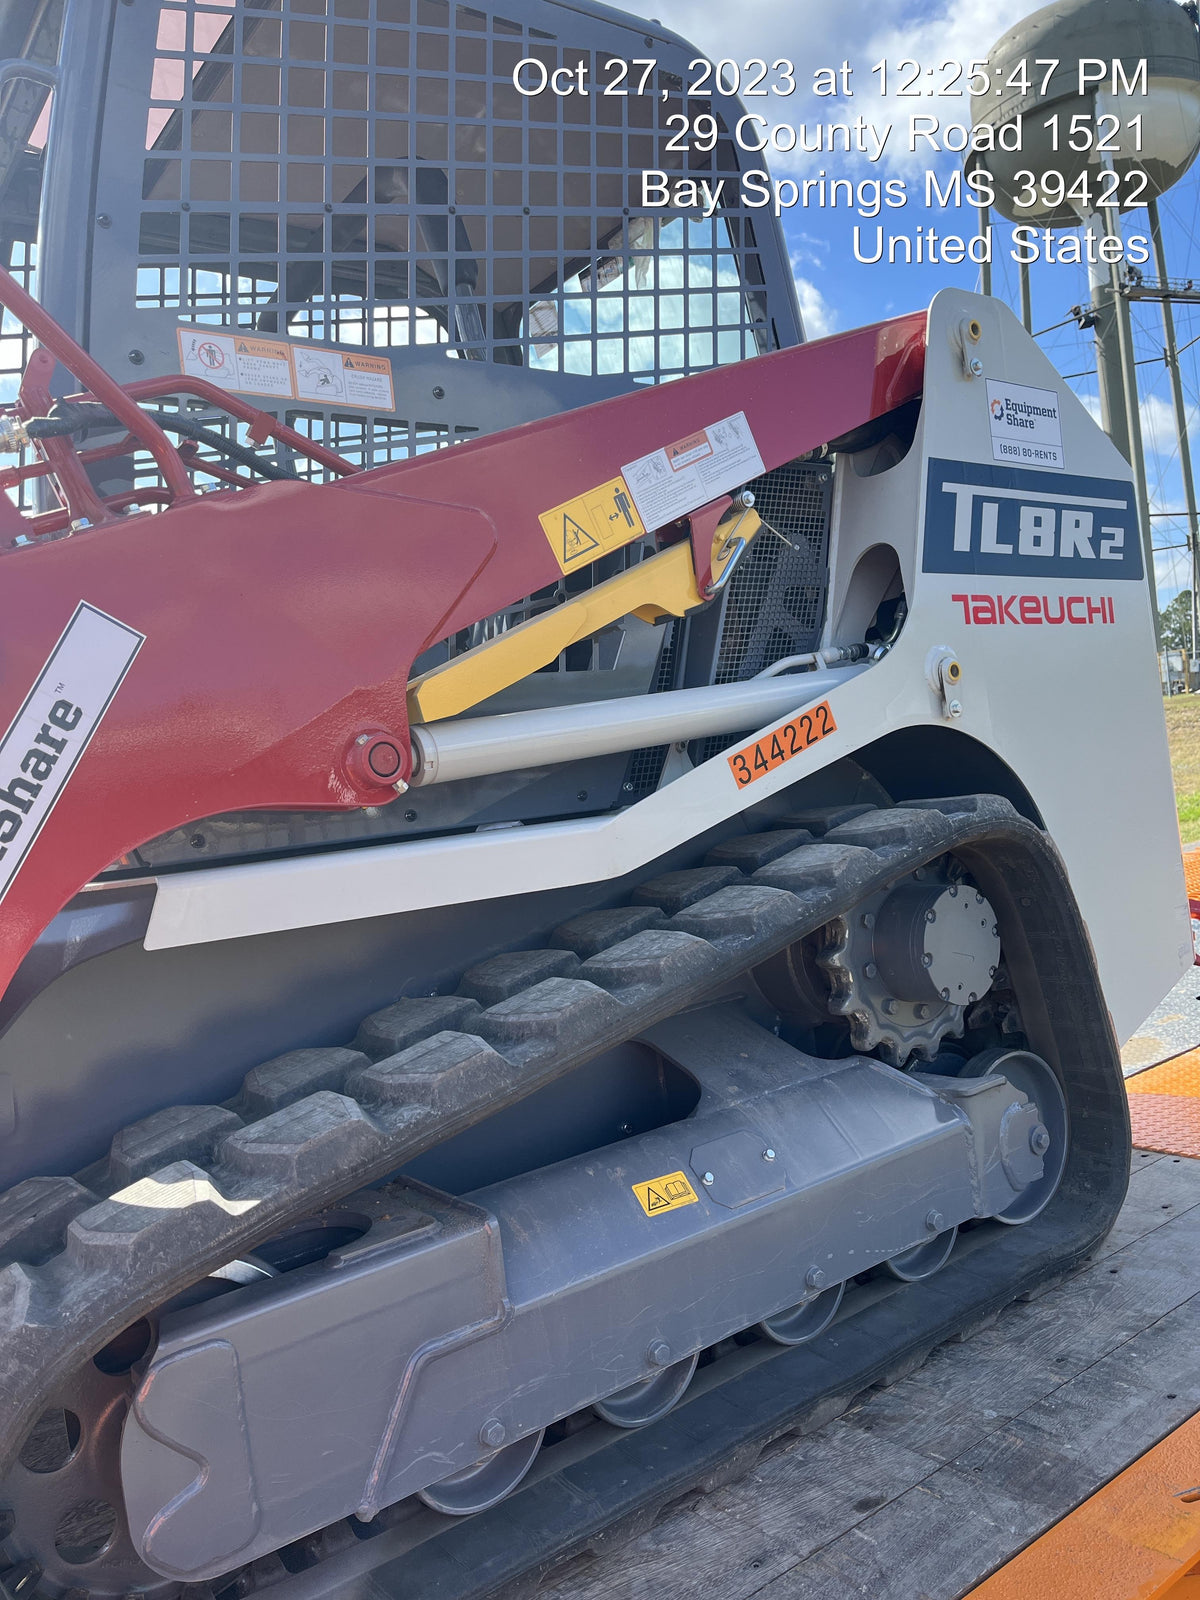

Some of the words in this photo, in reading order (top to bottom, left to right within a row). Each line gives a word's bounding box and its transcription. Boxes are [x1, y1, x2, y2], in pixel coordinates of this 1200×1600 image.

[354, 360, 386, 371] WARNING
[1004, 398, 1057, 419] Equipment
[1006, 413, 1035, 429] Share
[1000, 443, 1020, 456] (888)
[1022, 447, 1057, 461] 80-RENTS
[942, 482, 1127, 560] TL8R2
[733, 705, 834, 784] 344222
